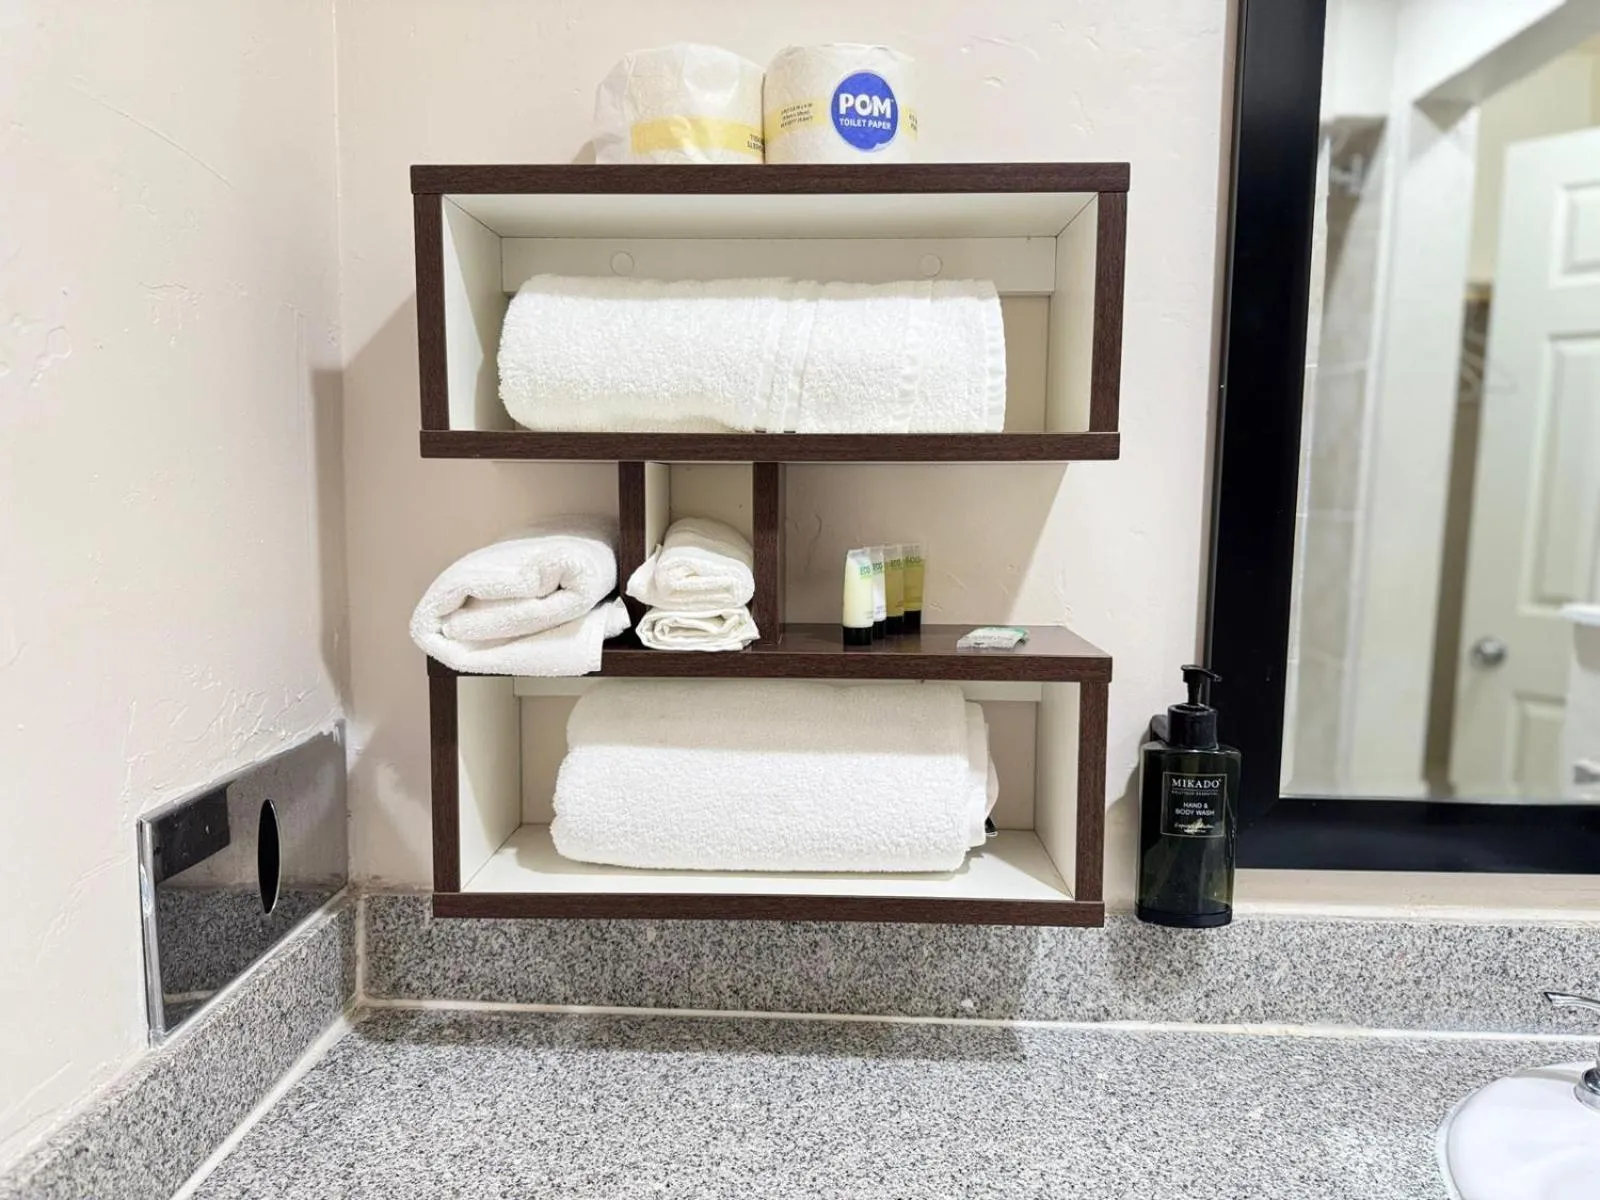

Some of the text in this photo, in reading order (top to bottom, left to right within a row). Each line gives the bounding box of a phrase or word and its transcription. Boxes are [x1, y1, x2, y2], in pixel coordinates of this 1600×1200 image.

[839, 93, 891, 118] POM
[839, 117, 892, 130] TOILET PAPER
[1171, 778, 1220, 788] MIKADO
[1175, 808, 1194, 816] BODY
